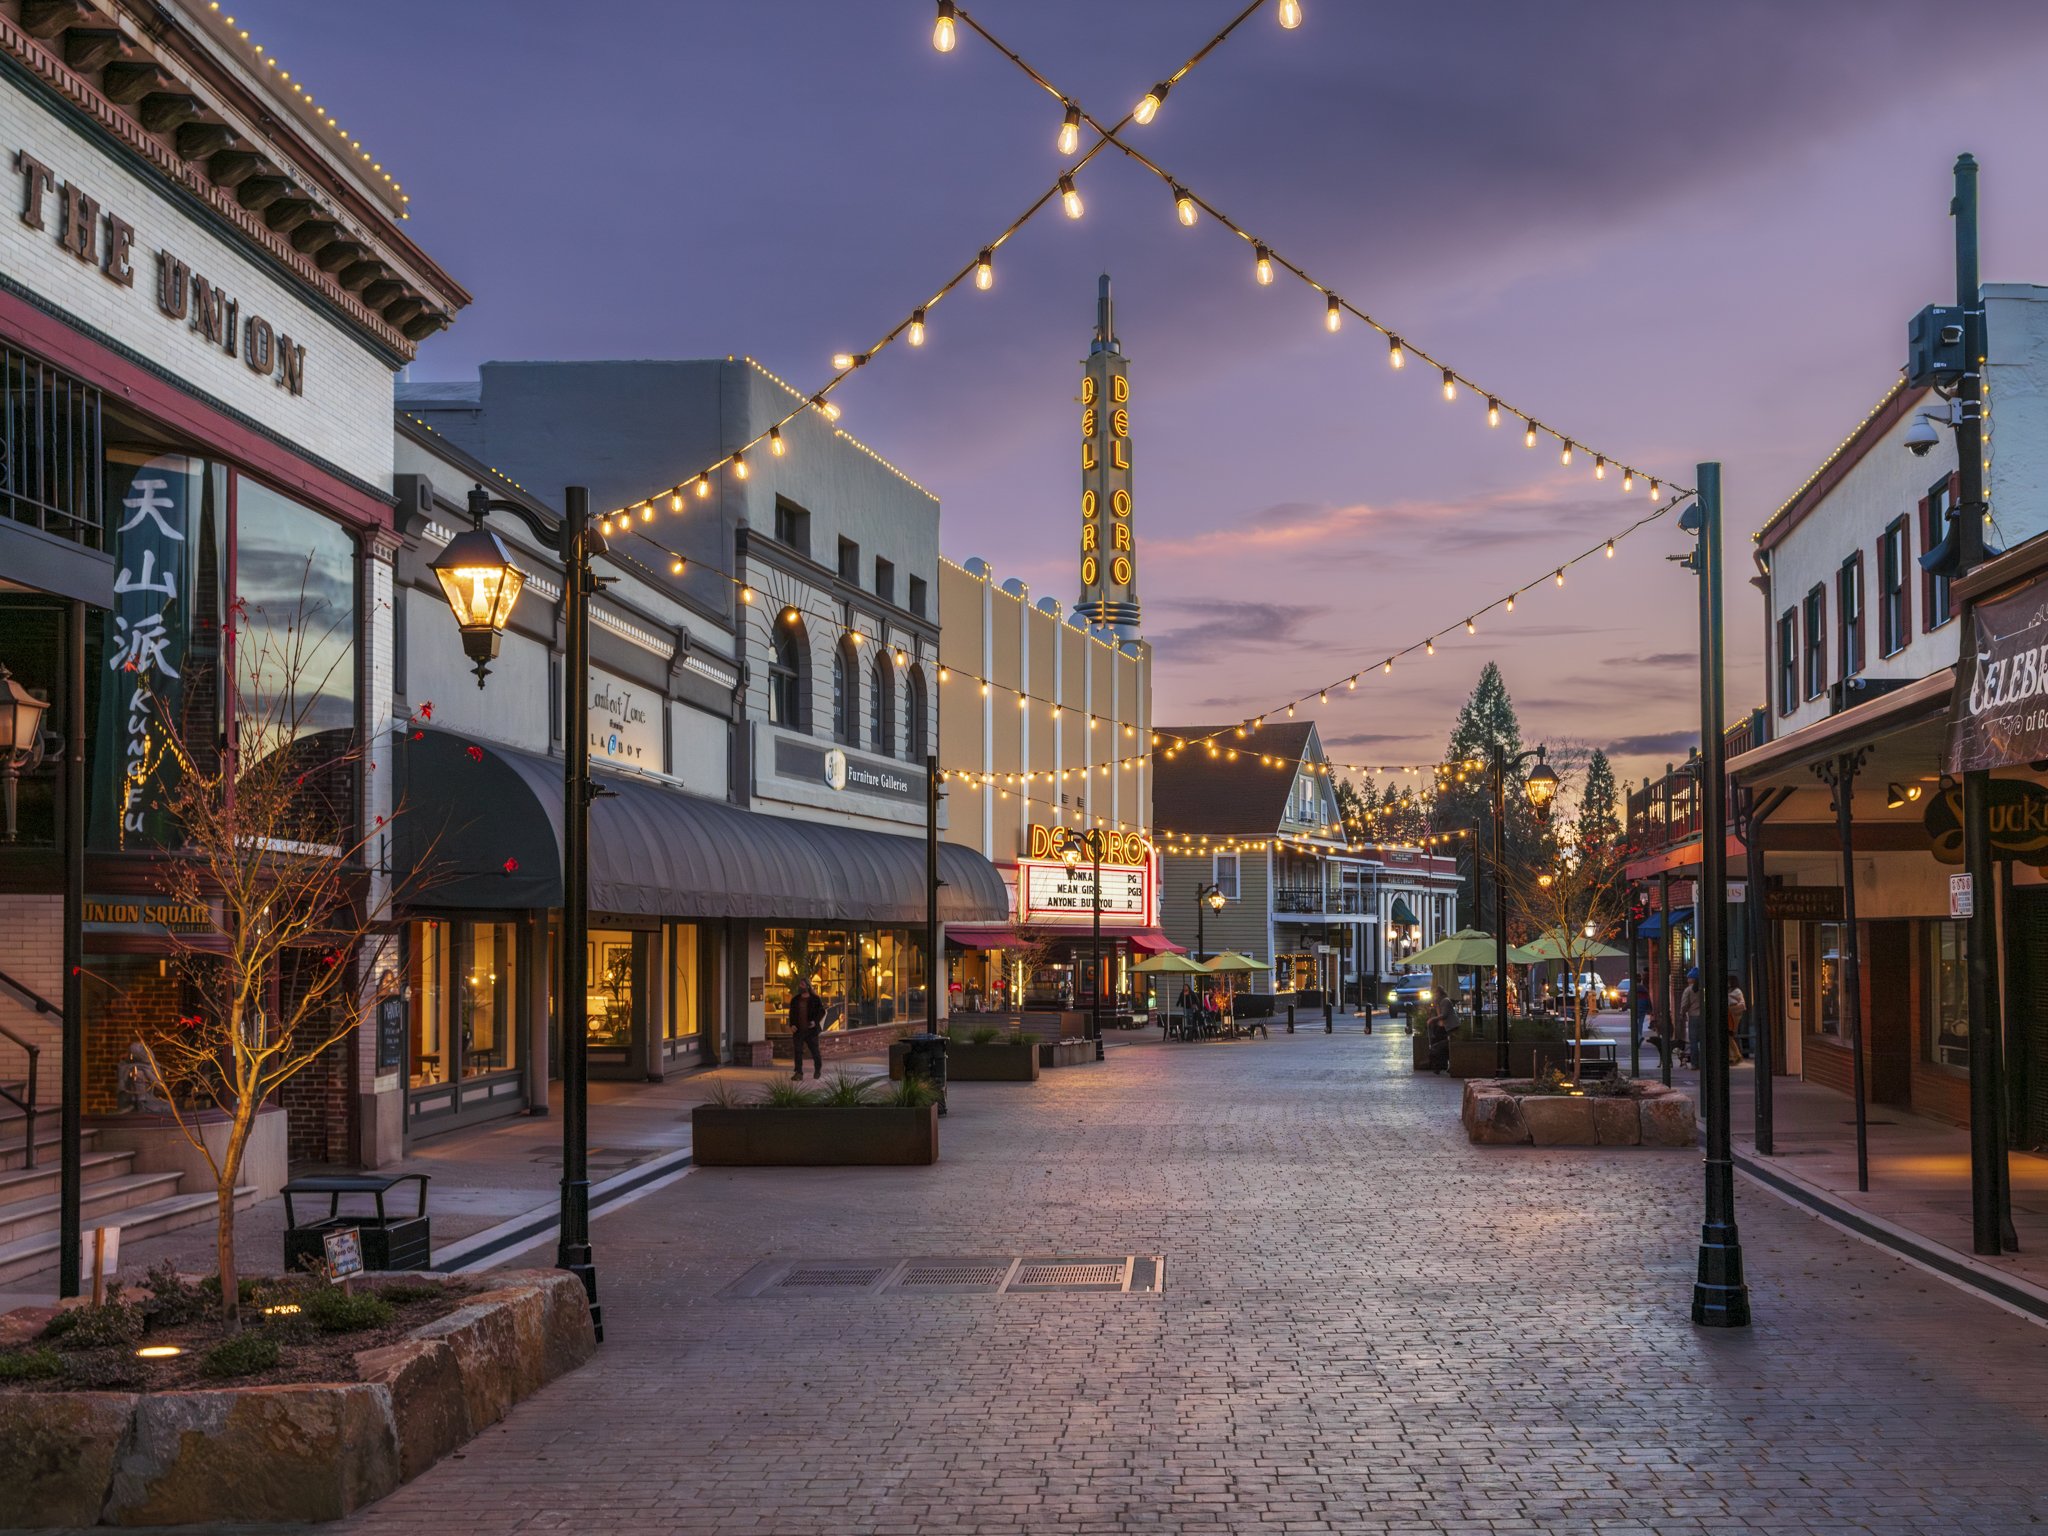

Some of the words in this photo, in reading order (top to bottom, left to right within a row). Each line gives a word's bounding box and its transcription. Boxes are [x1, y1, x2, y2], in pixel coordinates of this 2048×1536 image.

[19, 148, 135, 289] THE
[160, 248, 307, 397] UNION
[1081, 376, 1098, 470] DEL
[1110, 374, 1130, 470] DEL
[1081, 489, 1098, 585] ORO
[1111, 489, 1132, 585] ORO
[109, 479, 185, 679] 天山派
[127, 687, 151, 786] KUNG
[2025, 712, 2037, 733] of
[848, 766, 879, 786] Furniture
[881, 773, 908, 793] Galleries
[124, 788, 145, 833] FU
[1086, 829, 1144, 865] ORO
[1057, 884, 1078, 894] MEAN
[1081, 885, 1103, 895] GIRS
[1068, 871, 1093, 882] ONKA
[1127, 874, 1137, 884] PG
[82, 902, 140, 923] UNION
[143, 904, 210, 928] SQUARE
[1047, 897, 1077, 908] ANYONE
[1099, 899, 1113, 909] YOU
[1127, 900, 1133, 909] R
